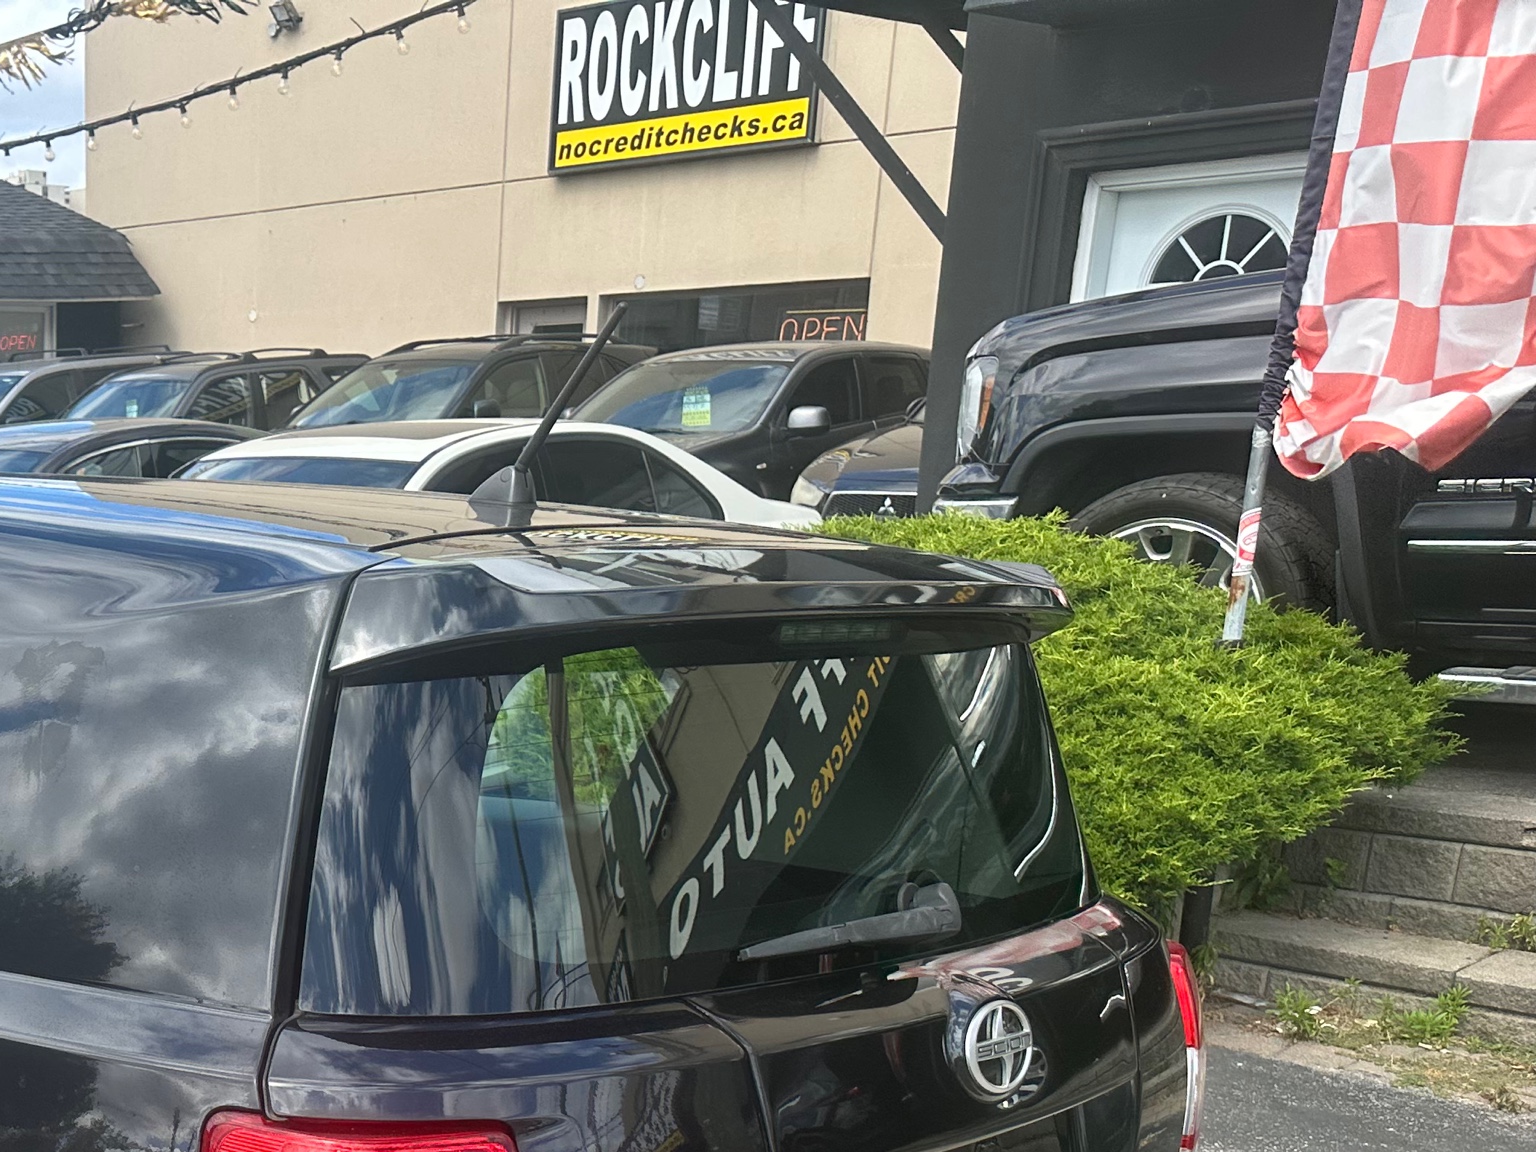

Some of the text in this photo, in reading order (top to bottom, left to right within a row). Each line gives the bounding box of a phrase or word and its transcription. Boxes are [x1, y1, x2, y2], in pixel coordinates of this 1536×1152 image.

[558, 111, 805, 160] nocreditchecks.ca
[779, 314, 865, 341] OPEN
[0, 334, 37, 351] OPEN
[1437, 478, 1536, 493] SIER
